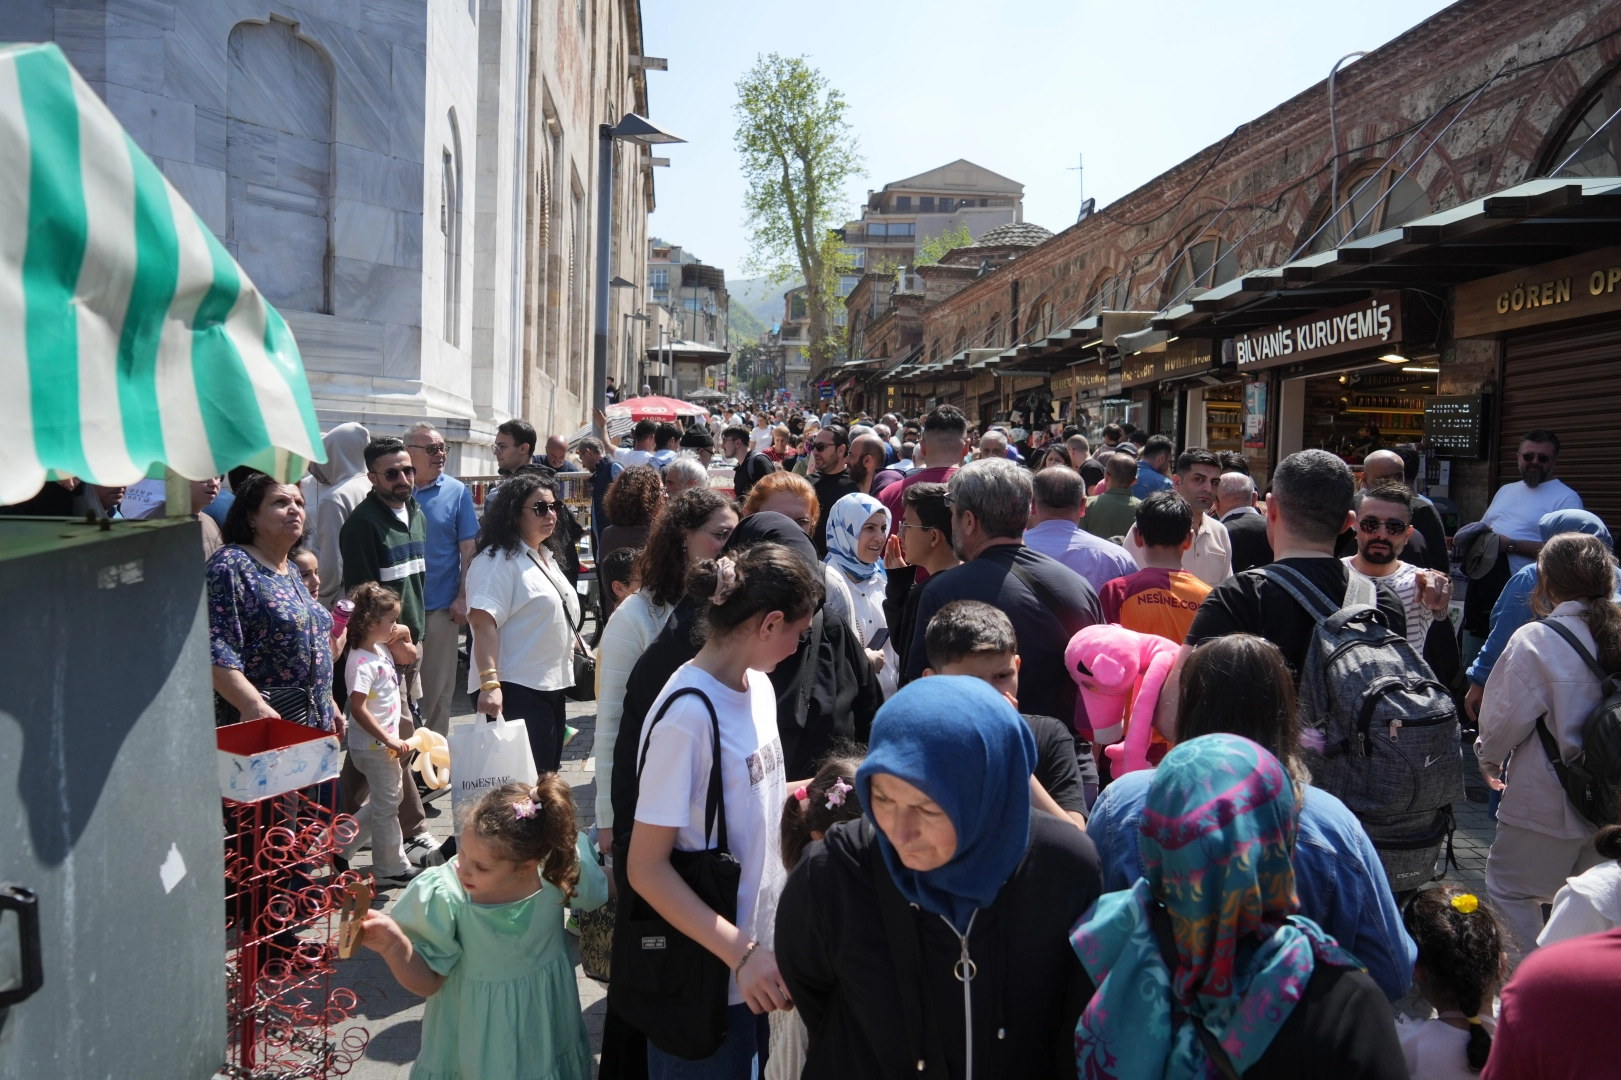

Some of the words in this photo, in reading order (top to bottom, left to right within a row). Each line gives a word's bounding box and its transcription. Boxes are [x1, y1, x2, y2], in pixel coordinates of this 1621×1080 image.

[1496, 277, 1572, 314] GÖREN
[1236, 325, 1292, 364] BİLVANİS
[1297, 300, 1391, 351] KURUYEMİŞ
[1138, 590, 1200, 611] NESİNE.CO
